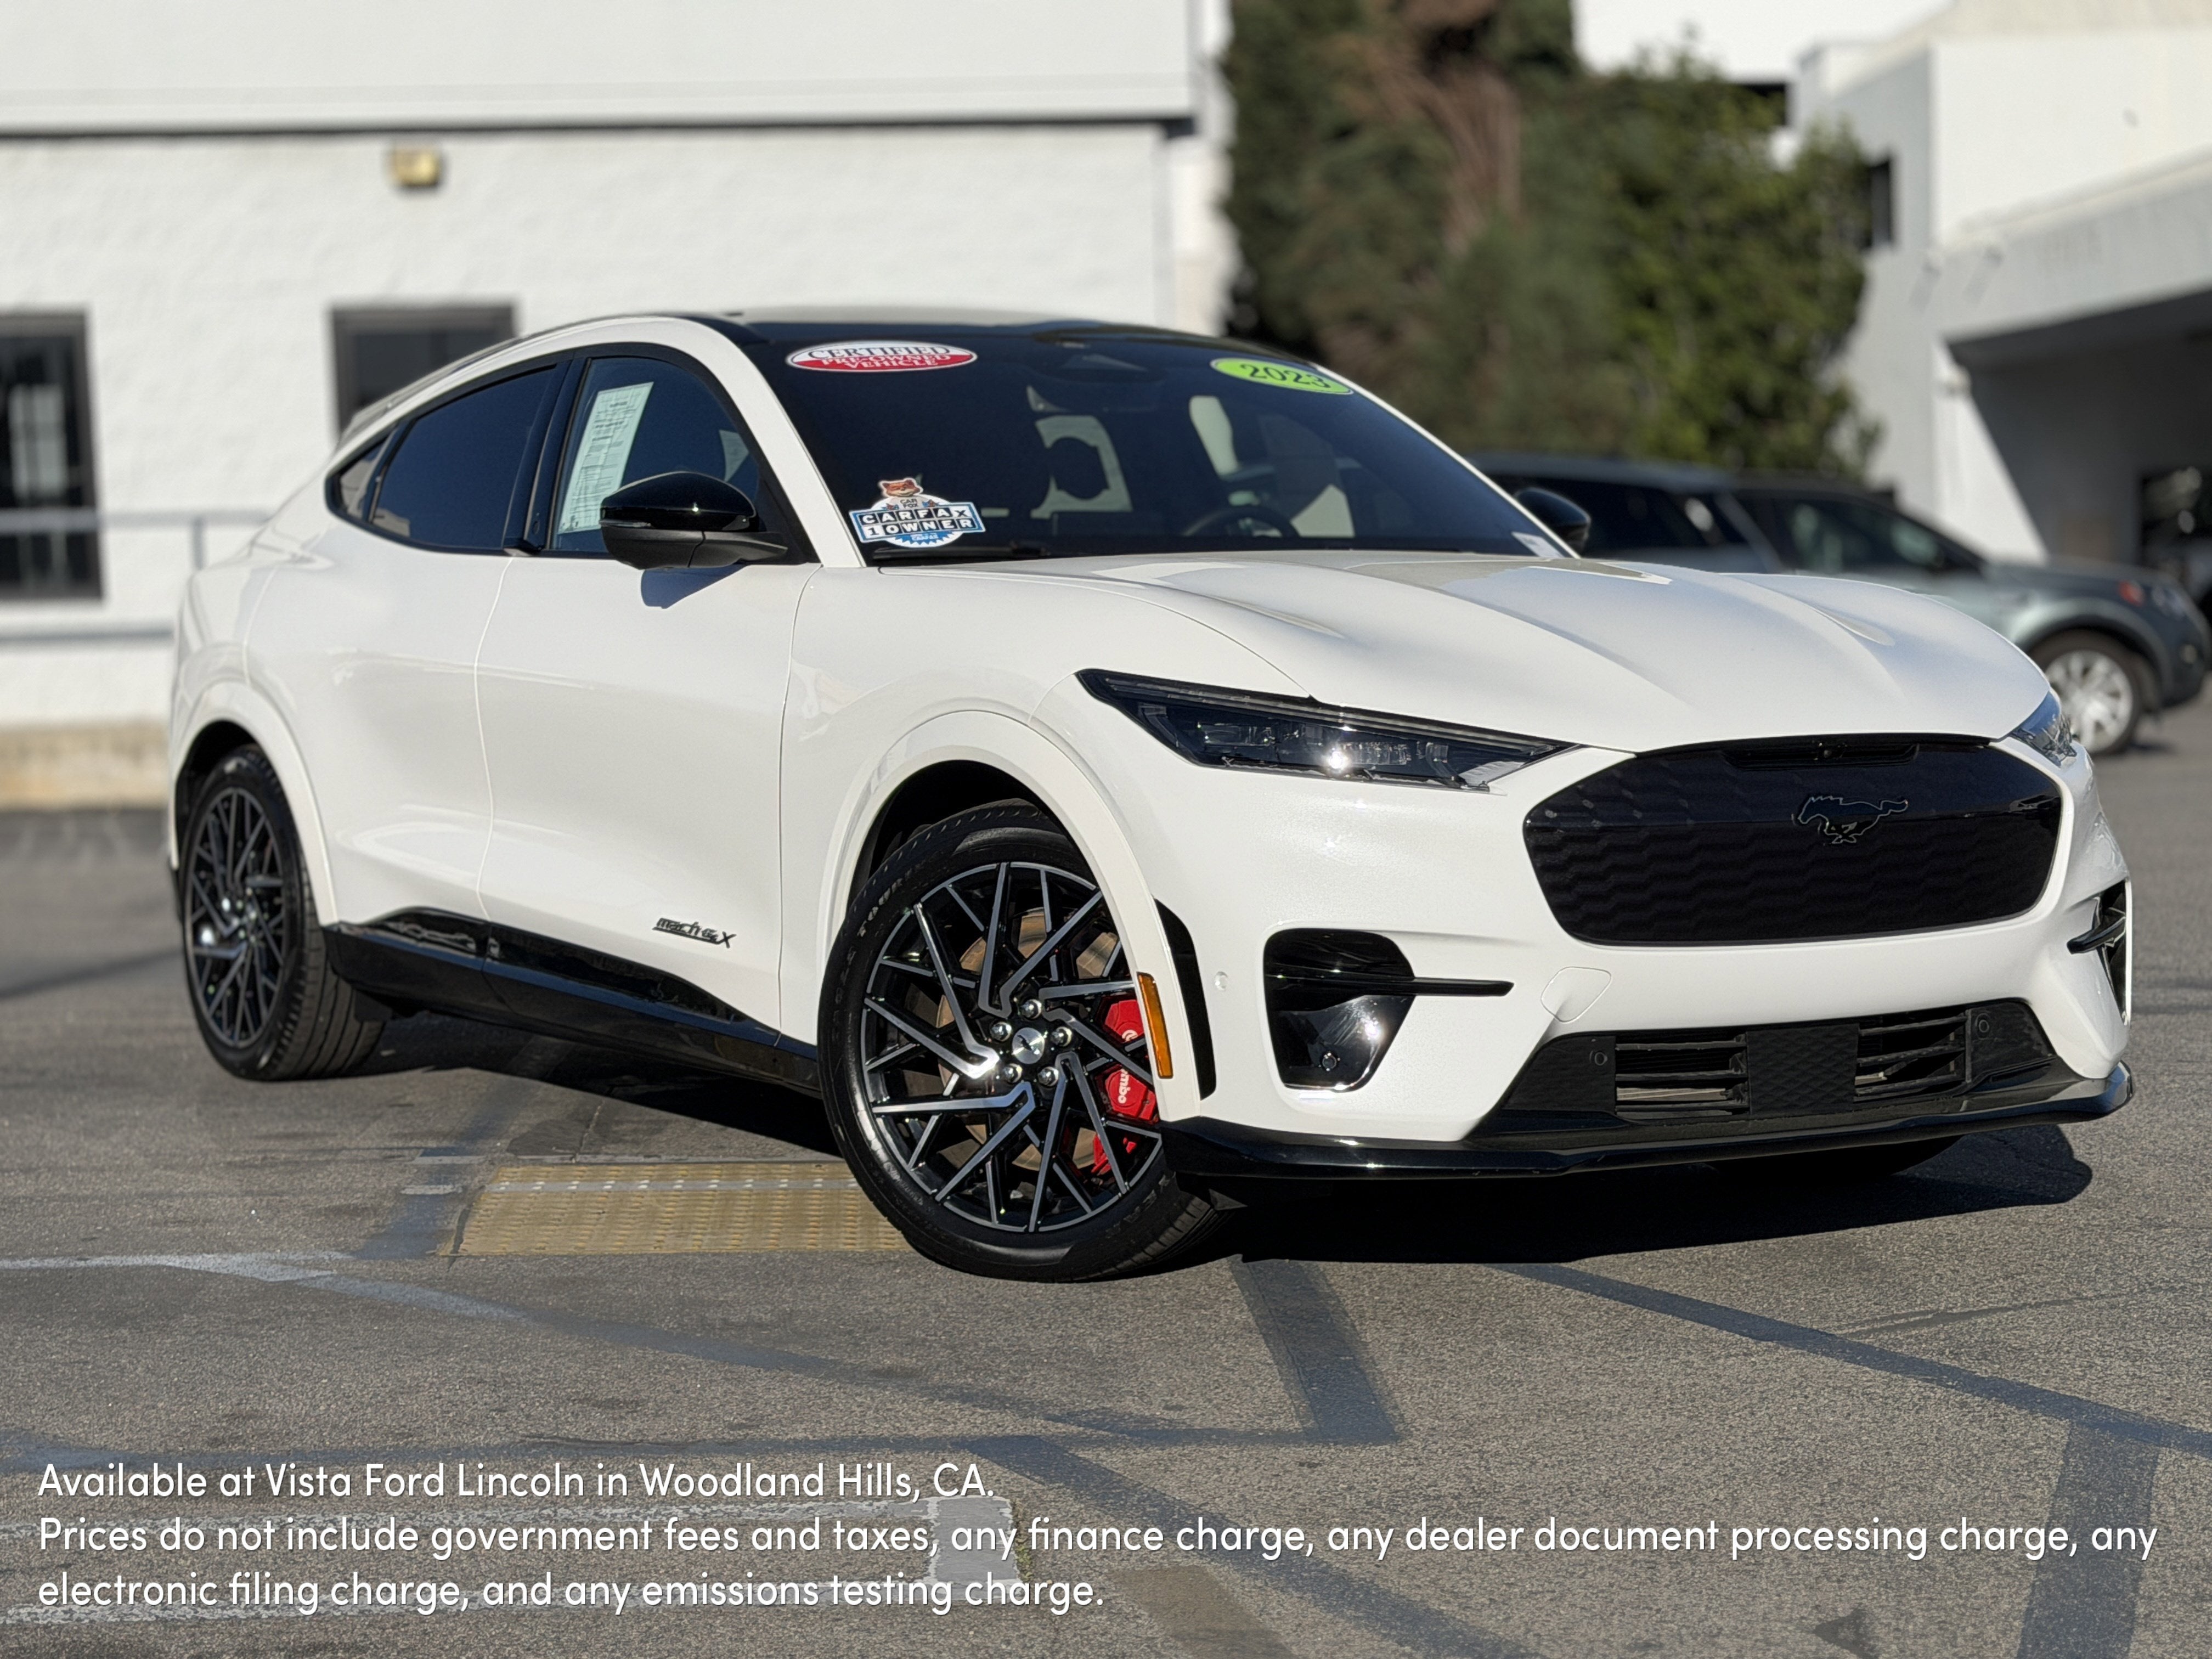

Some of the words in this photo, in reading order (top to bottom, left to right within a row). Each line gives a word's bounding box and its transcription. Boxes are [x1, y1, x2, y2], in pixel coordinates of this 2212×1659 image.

[808, 346, 950, 359] CERTIFIED
[821, 354, 952, 365] PRE-OWNED
[844, 358, 938, 368] VEHICLE
[1239, 363, 1331, 388] 2023
[862, 508, 970, 524] CARFAX
[885, 519, 973, 534] OWNER
